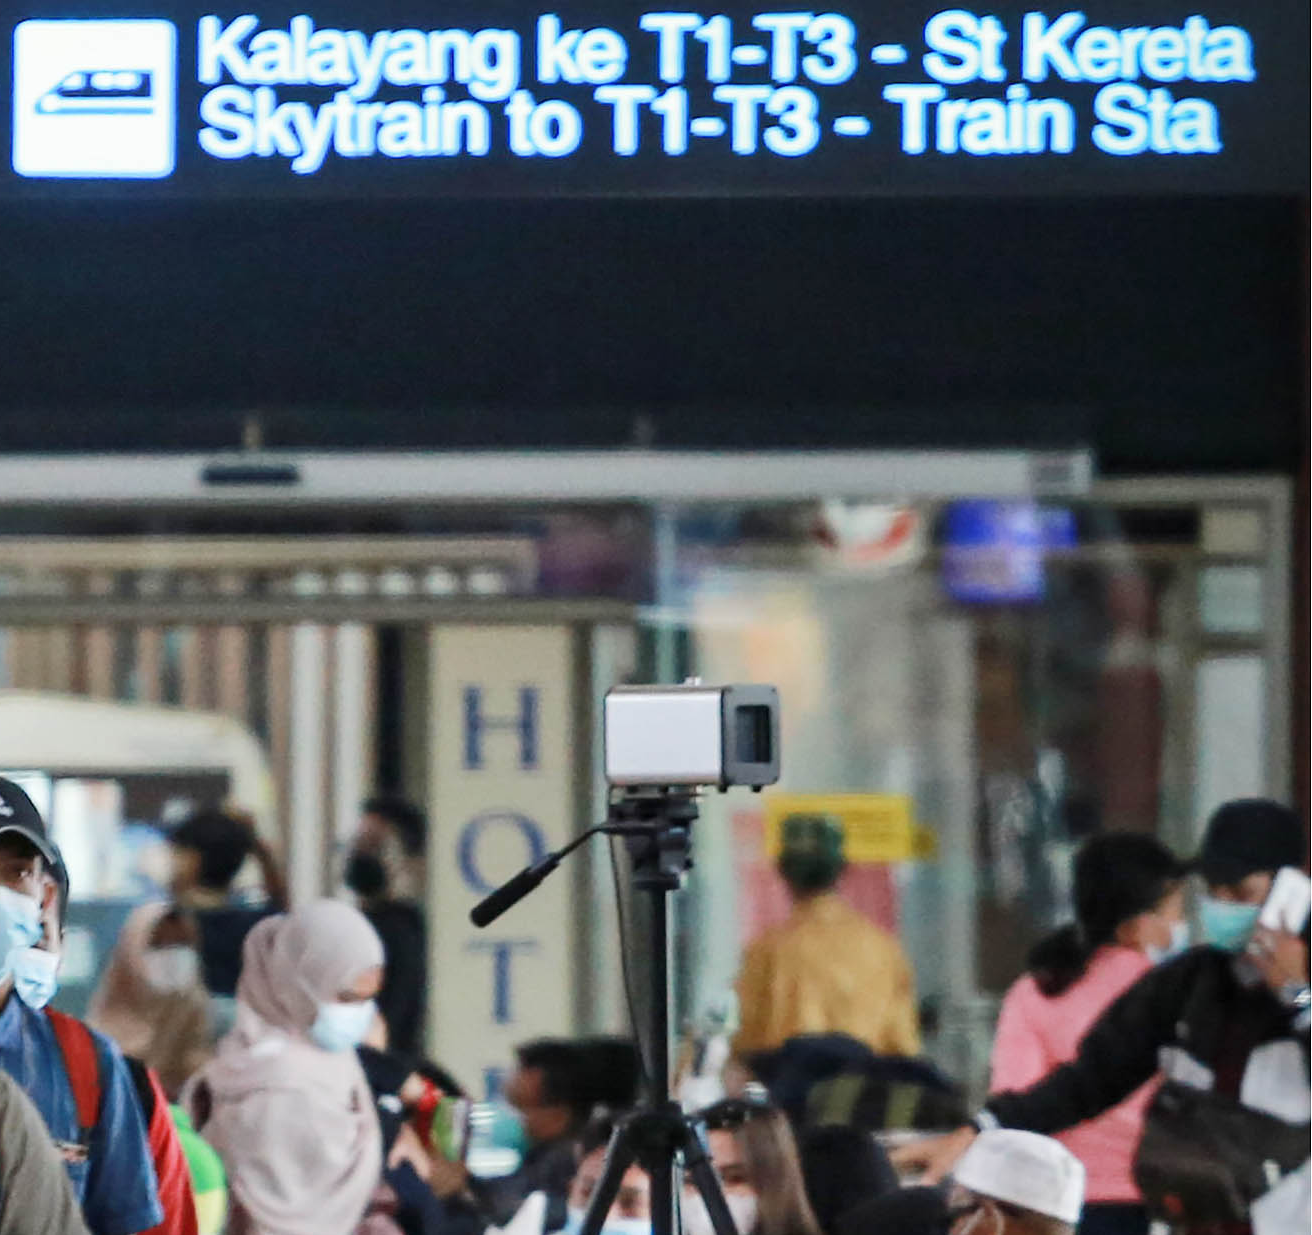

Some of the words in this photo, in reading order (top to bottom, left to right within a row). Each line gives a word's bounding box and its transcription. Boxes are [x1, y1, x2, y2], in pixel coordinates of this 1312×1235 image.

[197, 14, 519, 101] Kalayang
[537, 13, 628, 84] ke
[639, 12, 858, 84] T1-T3
[922, 9, 1007, 84] St
[1021, 11, 1257, 84] Kereta
[197, 84, 491, 175] Skytrain
[505, 88, 583, 158] to
[593, 84, 821, 157] T1-T3
[882, 83, 1075, 155] Train
[1091, 82, 1224, 156] Sta
[457, 685, 547, 1103] HOT
